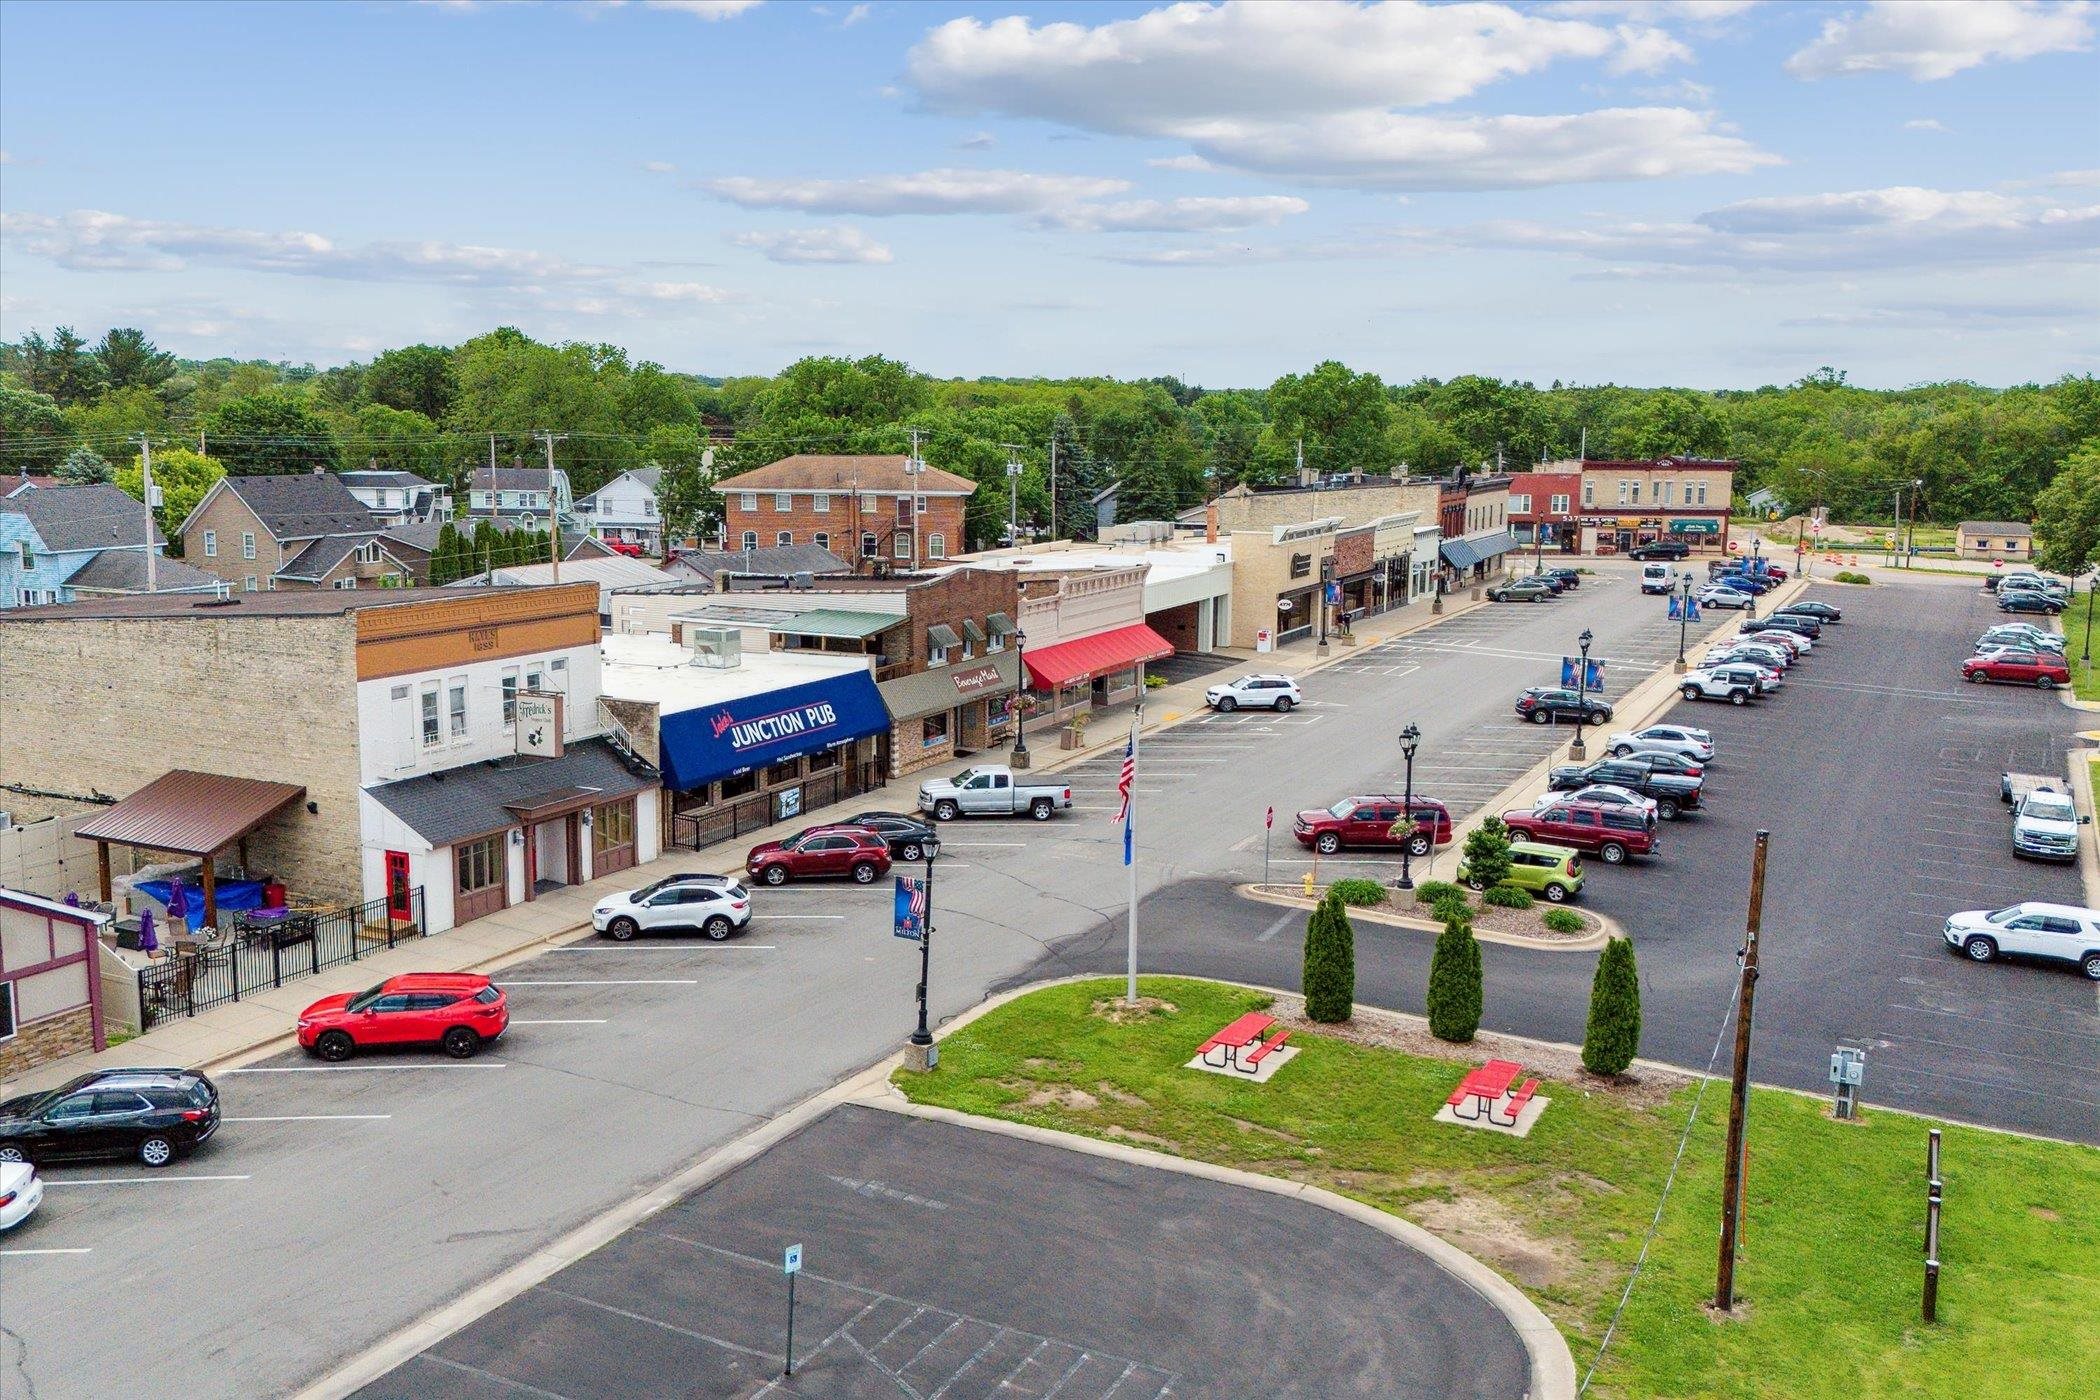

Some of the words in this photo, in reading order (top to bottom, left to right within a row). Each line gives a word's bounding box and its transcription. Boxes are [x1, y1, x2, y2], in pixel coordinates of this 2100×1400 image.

[953, 675, 984, 688] Beverage
[980, 668, 999, 681] Mart
[732, 711, 805, 748] JUNCTION
[805, 704, 837, 728] PUB
